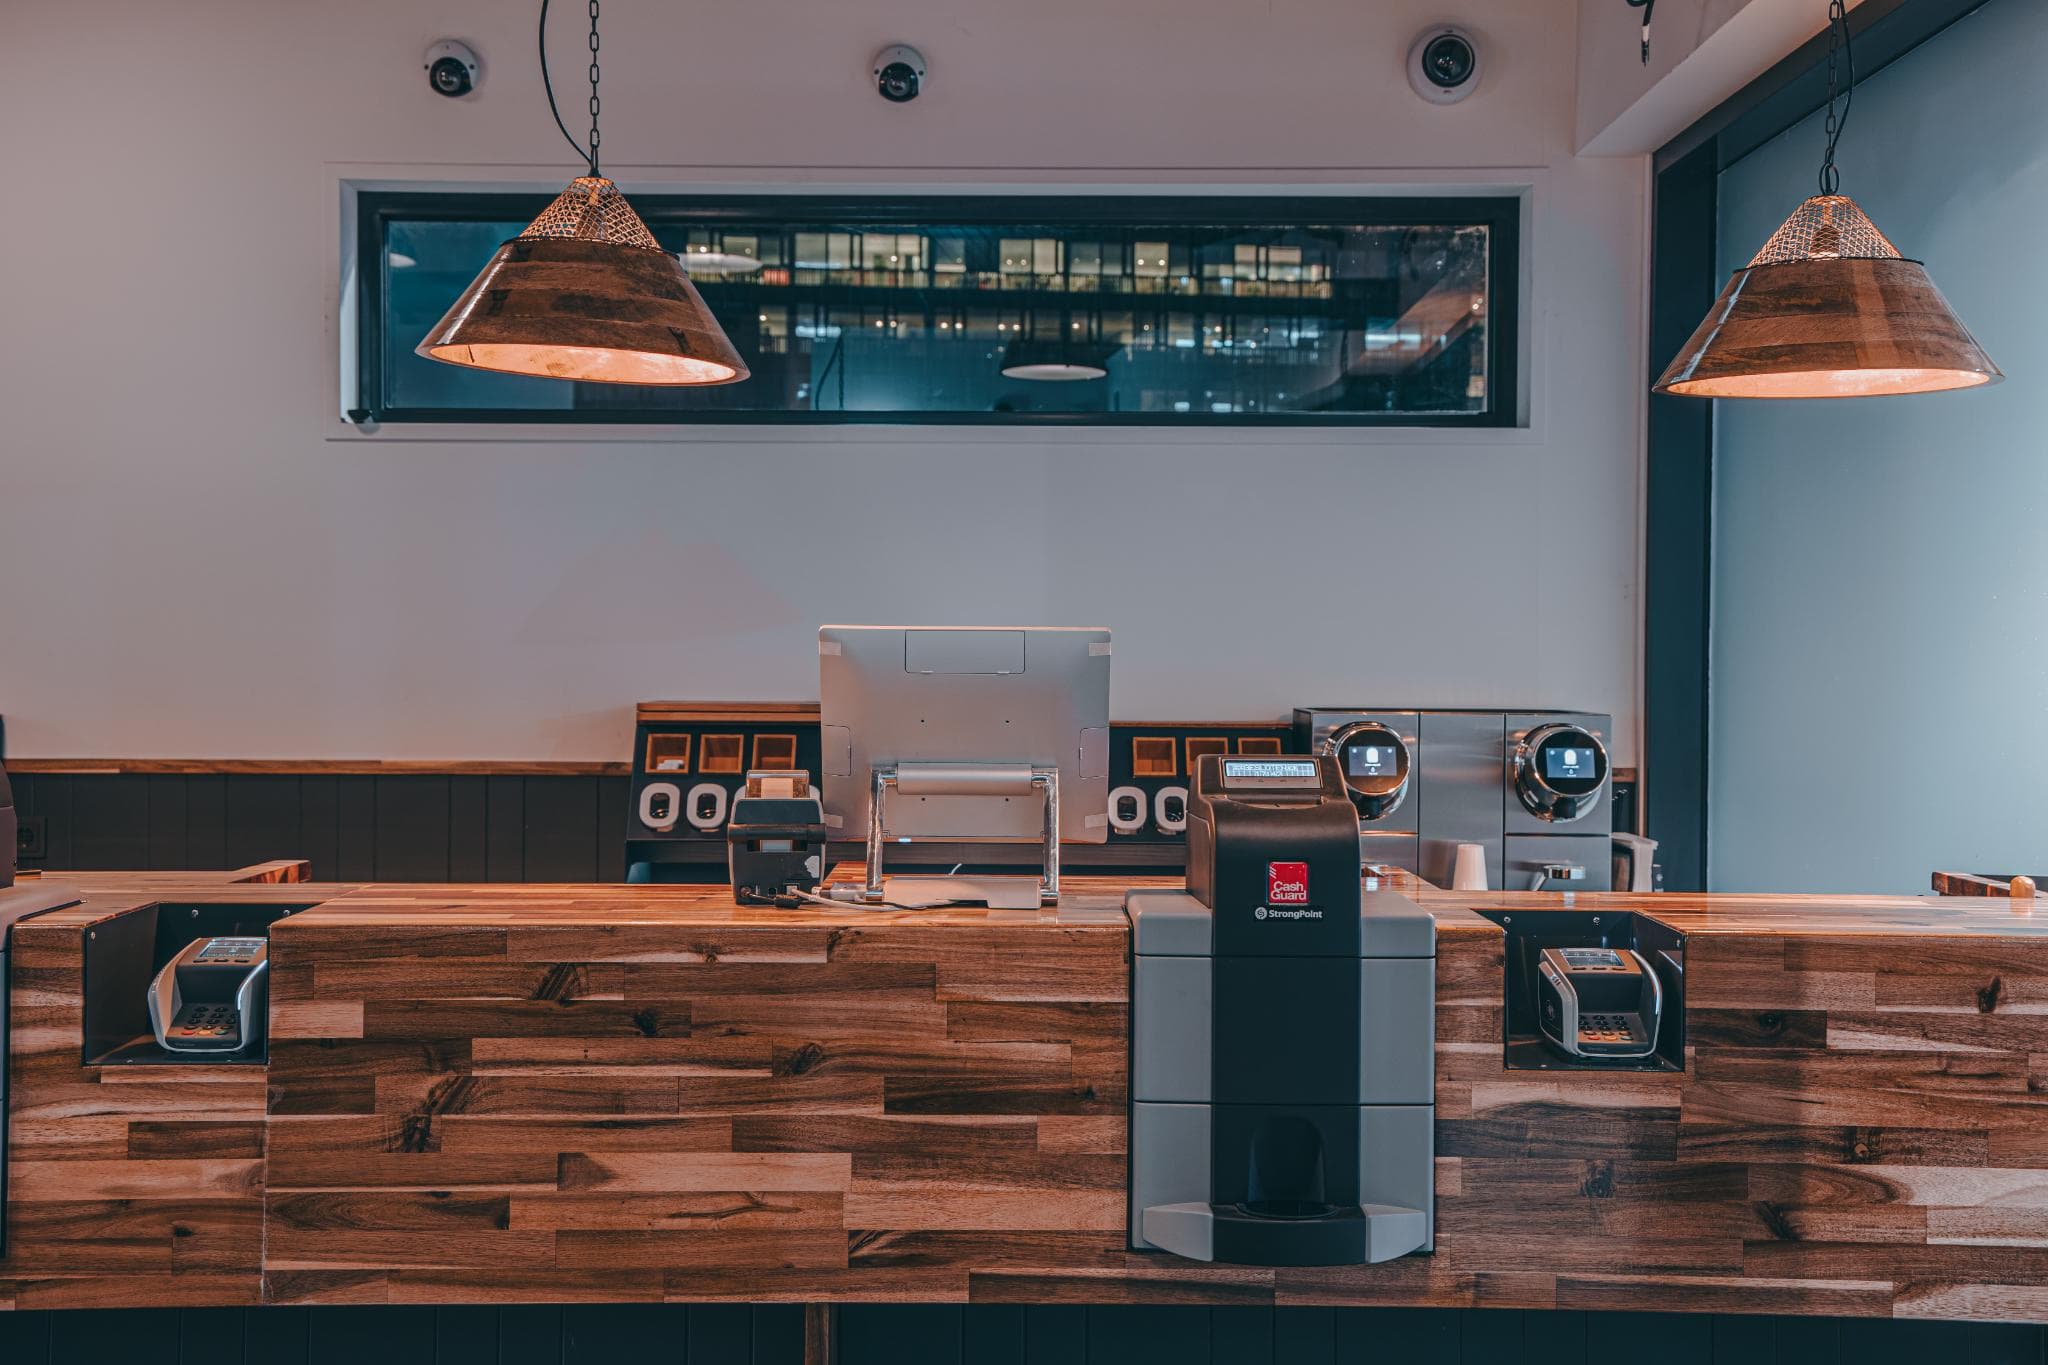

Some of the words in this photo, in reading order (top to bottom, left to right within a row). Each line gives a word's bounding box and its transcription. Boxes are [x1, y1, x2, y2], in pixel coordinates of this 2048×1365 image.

[1273, 881, 1304, 892] Cash
[1270, 889, 1307, 900] Guard
[1268, 909, 1323, 920] StrongPoint
